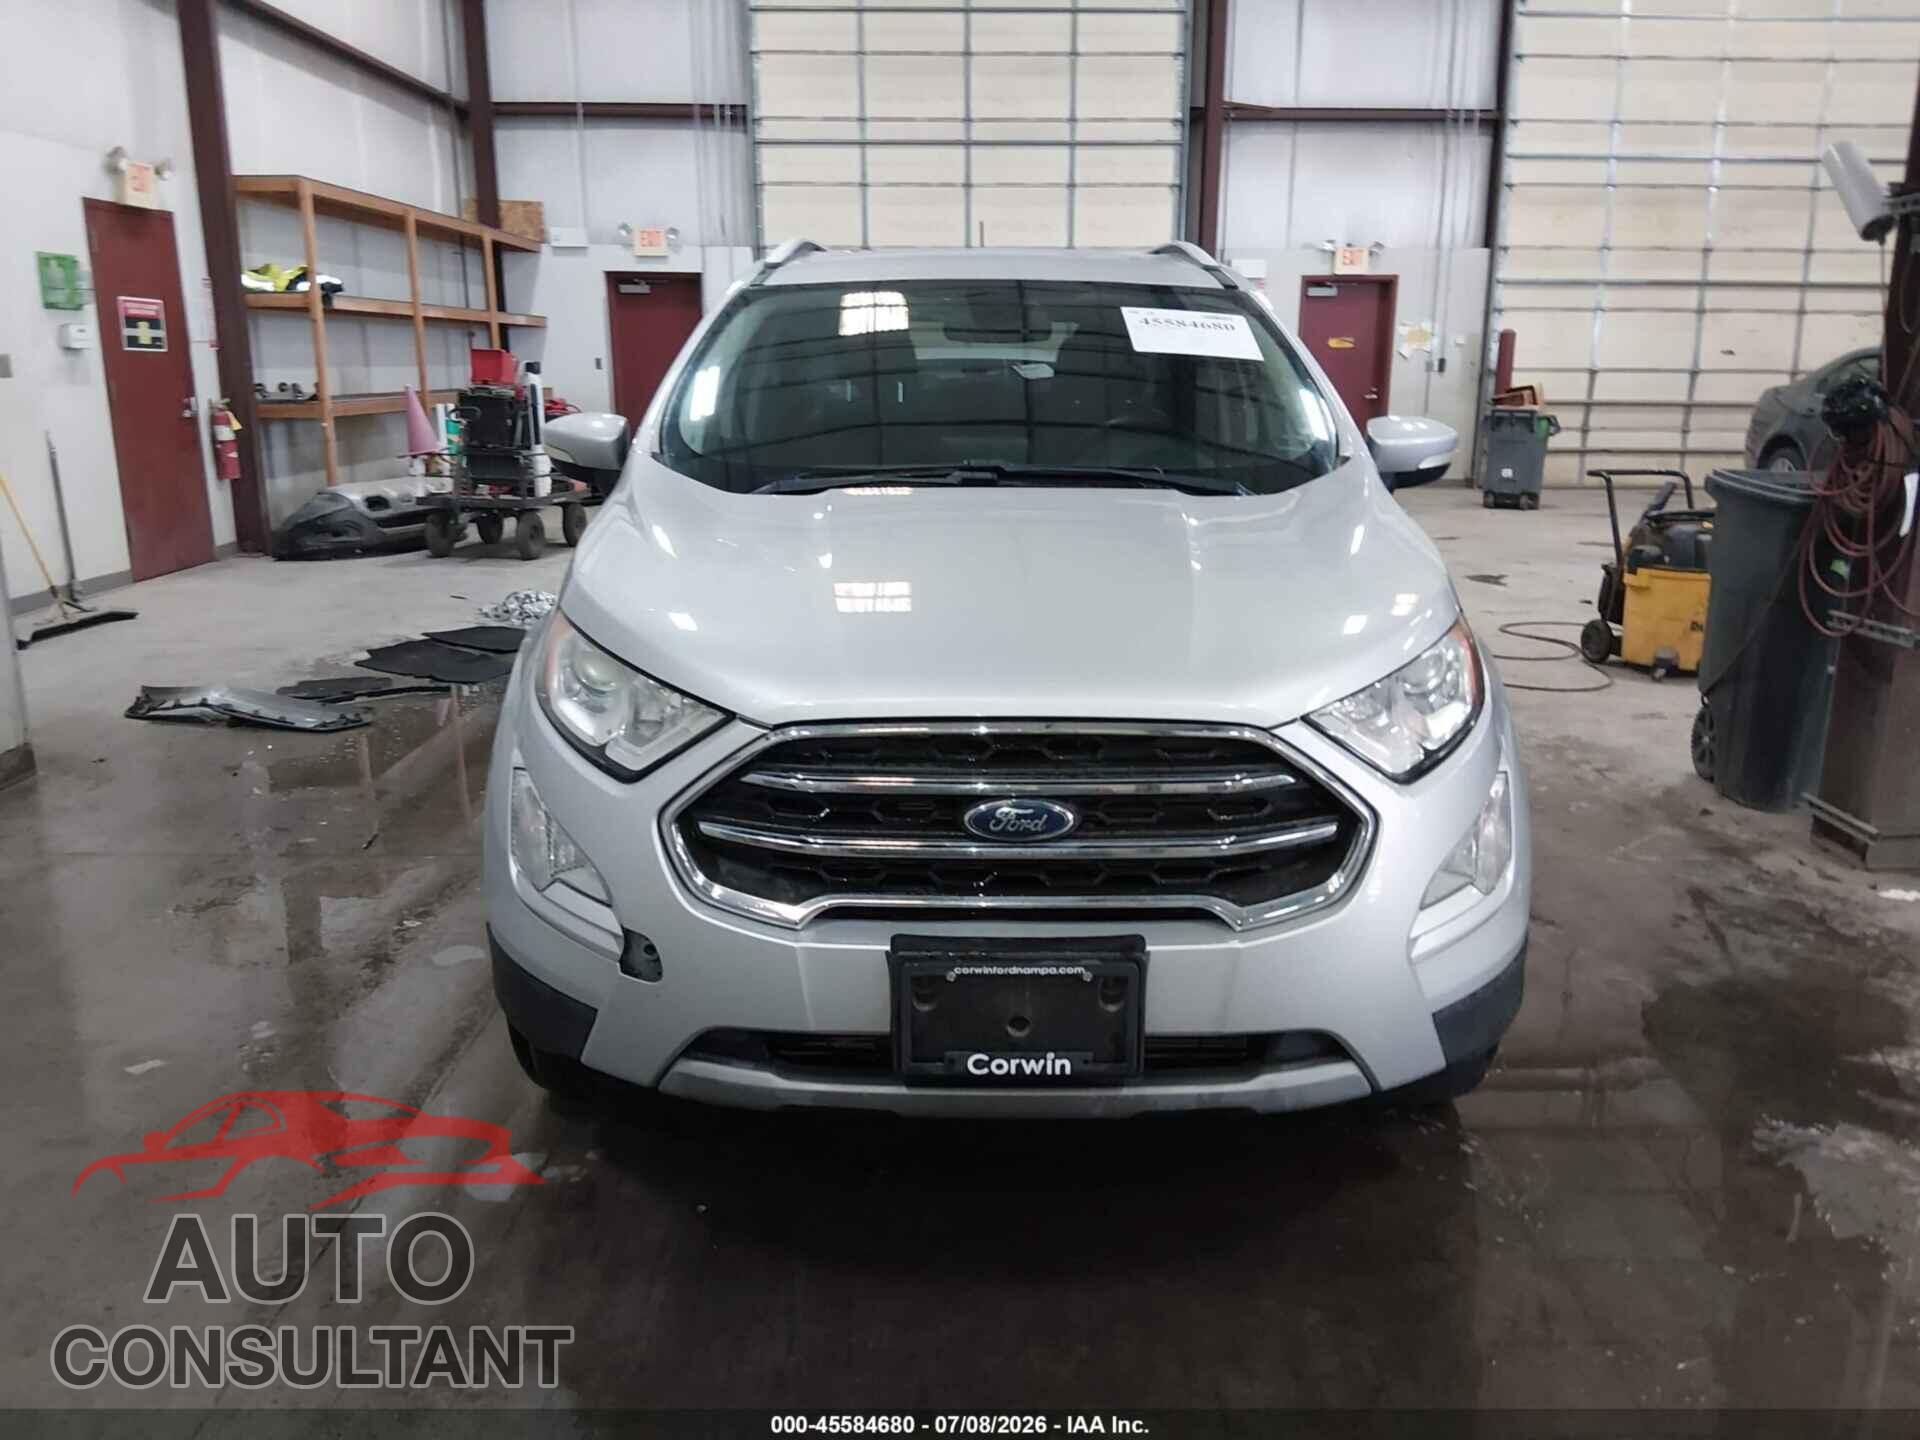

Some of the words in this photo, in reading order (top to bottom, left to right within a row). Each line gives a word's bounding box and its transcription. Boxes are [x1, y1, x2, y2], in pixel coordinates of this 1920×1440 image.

[988, 806, 1049, 833] Ford
[953, 965, 1086, 976] corwinfordnampa.com
[966, 1052, 1071, 1075] Corwin
